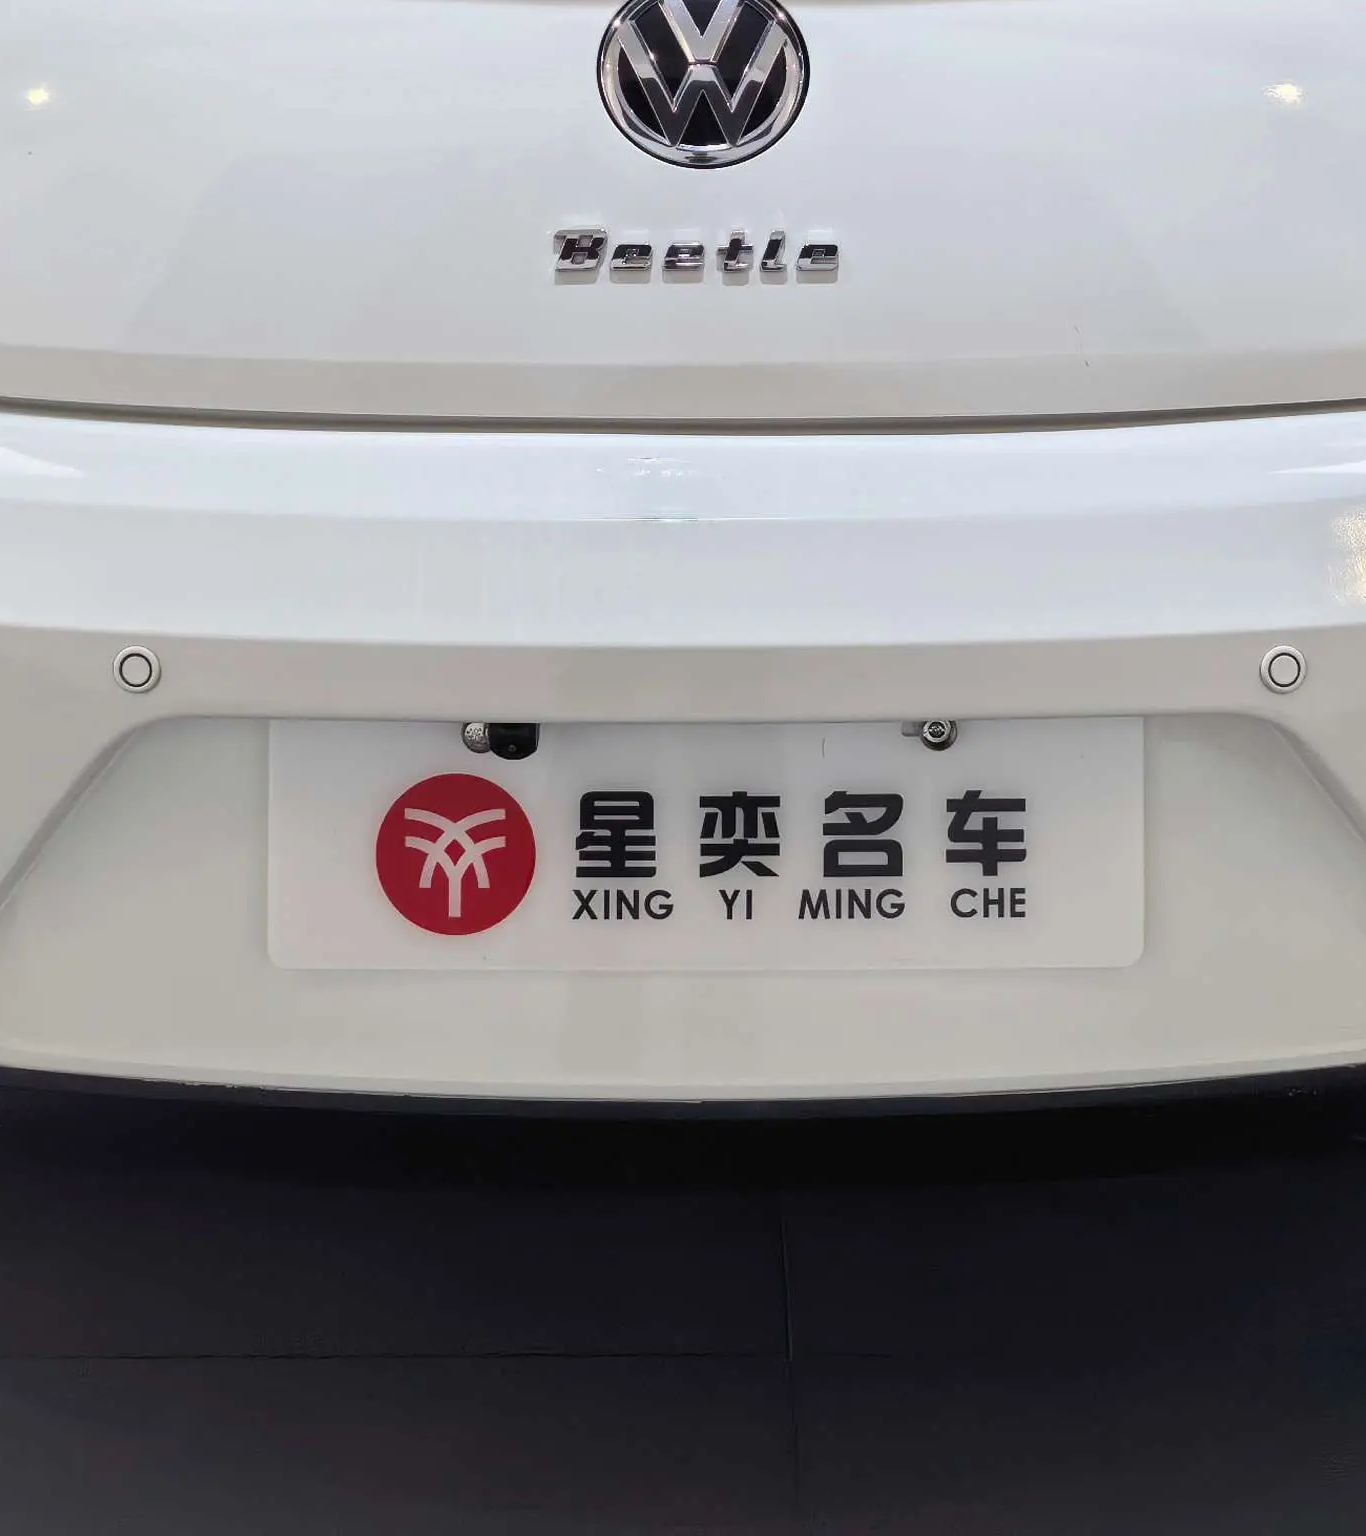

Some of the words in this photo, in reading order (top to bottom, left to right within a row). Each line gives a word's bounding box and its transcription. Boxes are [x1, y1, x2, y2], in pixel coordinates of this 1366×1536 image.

[552, 228, 841, 273] Beetle
[574, 790, 1028, 878] 星奕名车
[572, 889, 675, 921] XING
[719, 889, 753, 920] YI
[797, 888, 906, 920] MING
[950, 887, 1027, 919] CHE
